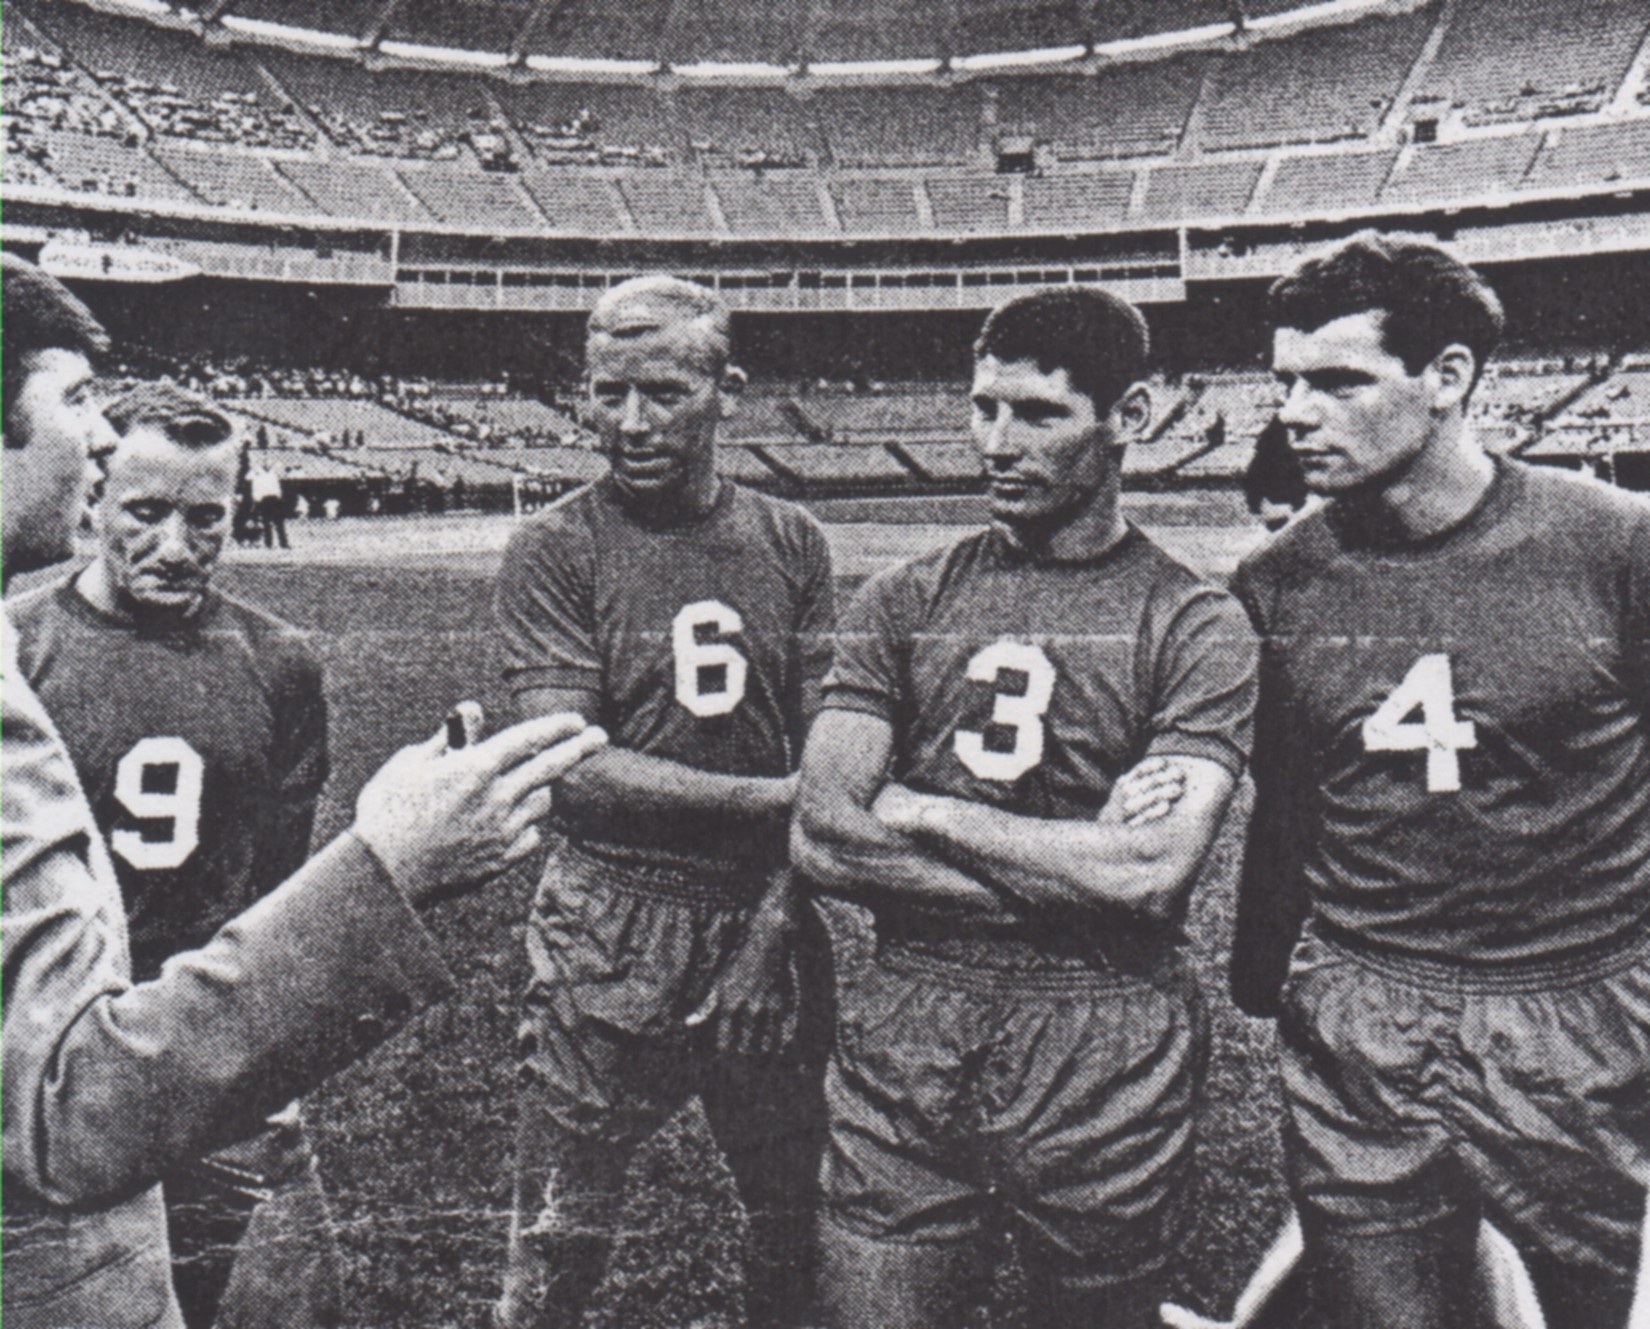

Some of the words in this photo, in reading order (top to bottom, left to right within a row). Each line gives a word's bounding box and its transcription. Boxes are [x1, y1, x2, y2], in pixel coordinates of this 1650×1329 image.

[672, 601, 746, 716] 6
[954, 640, 1055, 780] 3
[1363, 654, 1476, 791] 4
[113, 737, 203, 868] 9
